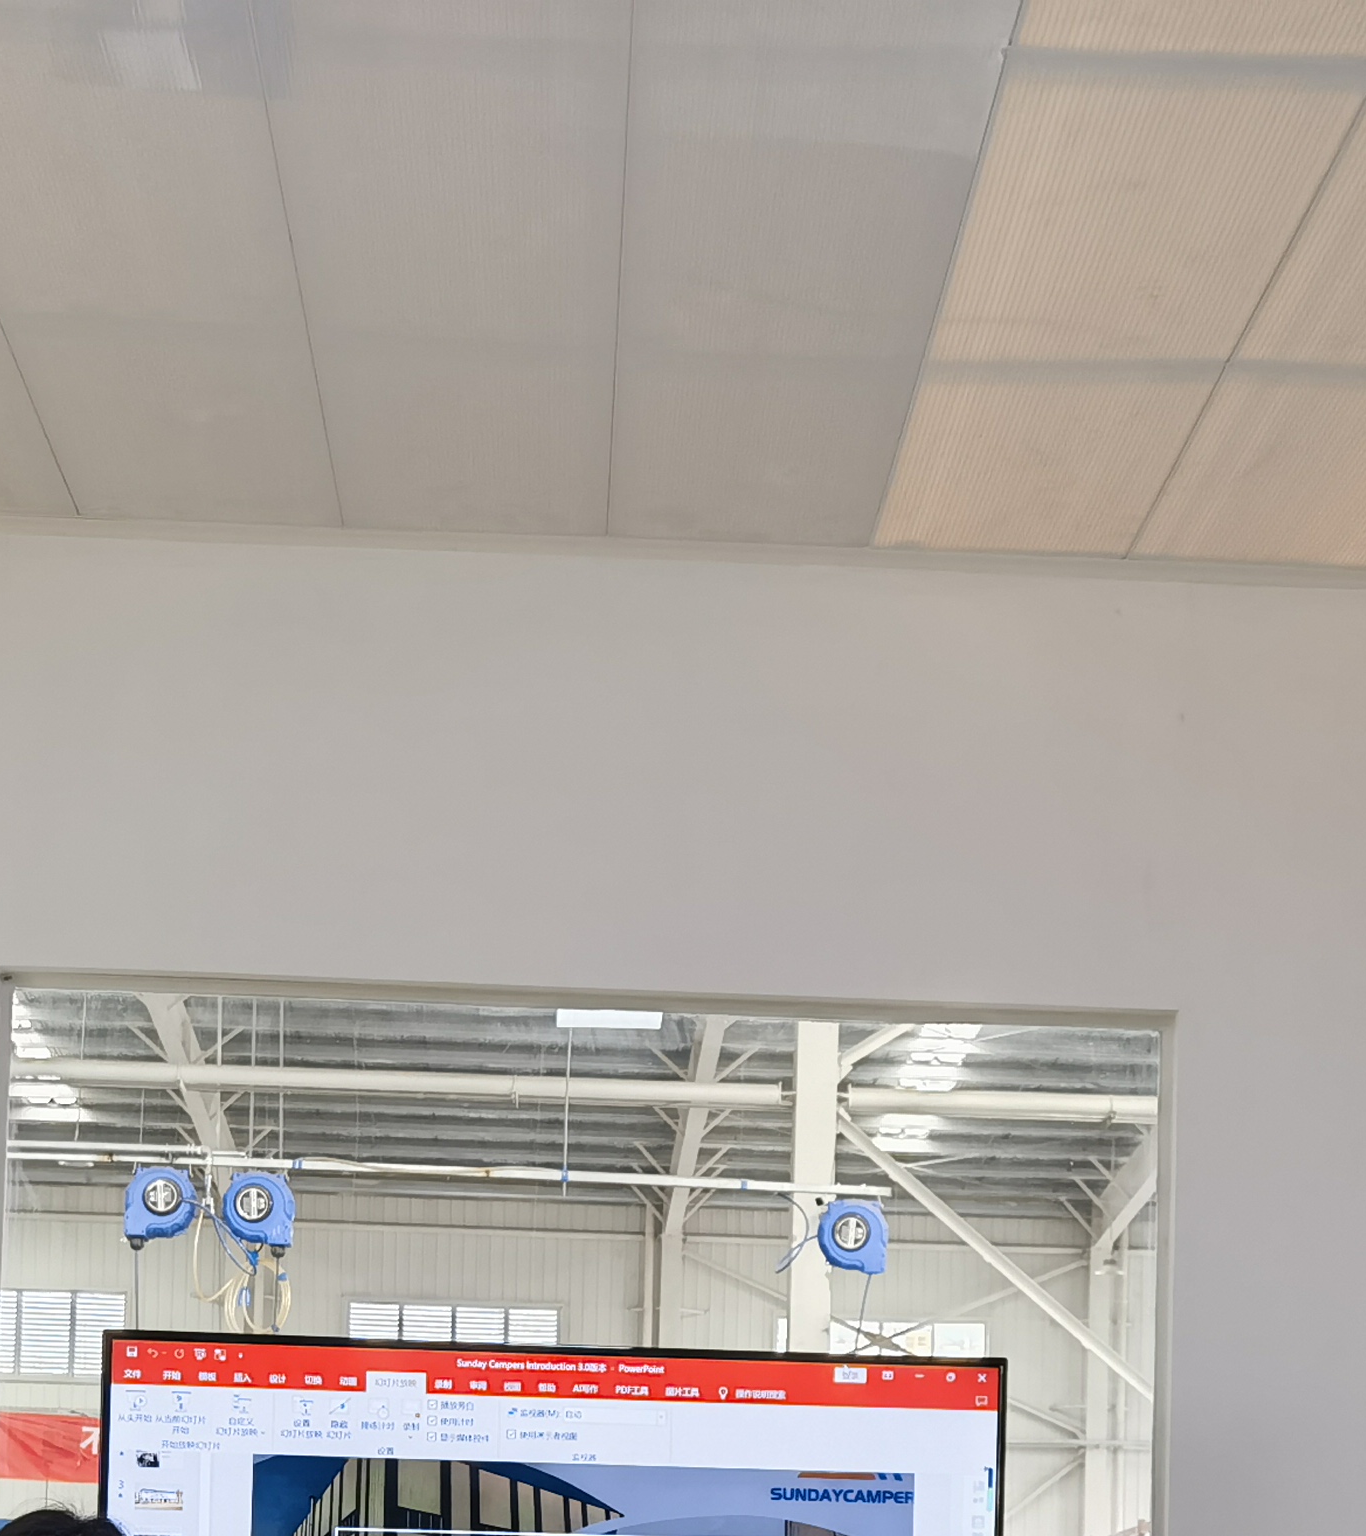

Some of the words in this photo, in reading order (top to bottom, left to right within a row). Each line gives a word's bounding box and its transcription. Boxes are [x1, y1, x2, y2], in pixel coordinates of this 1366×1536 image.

[456, 1358, 487, 1369] Sunday
[526, 1361, 576, 1371] Introduction
[619, 1364, 665, 1374] PowerPoint
[770, 1487, 915, 1505] SUNDAYCAMPER
